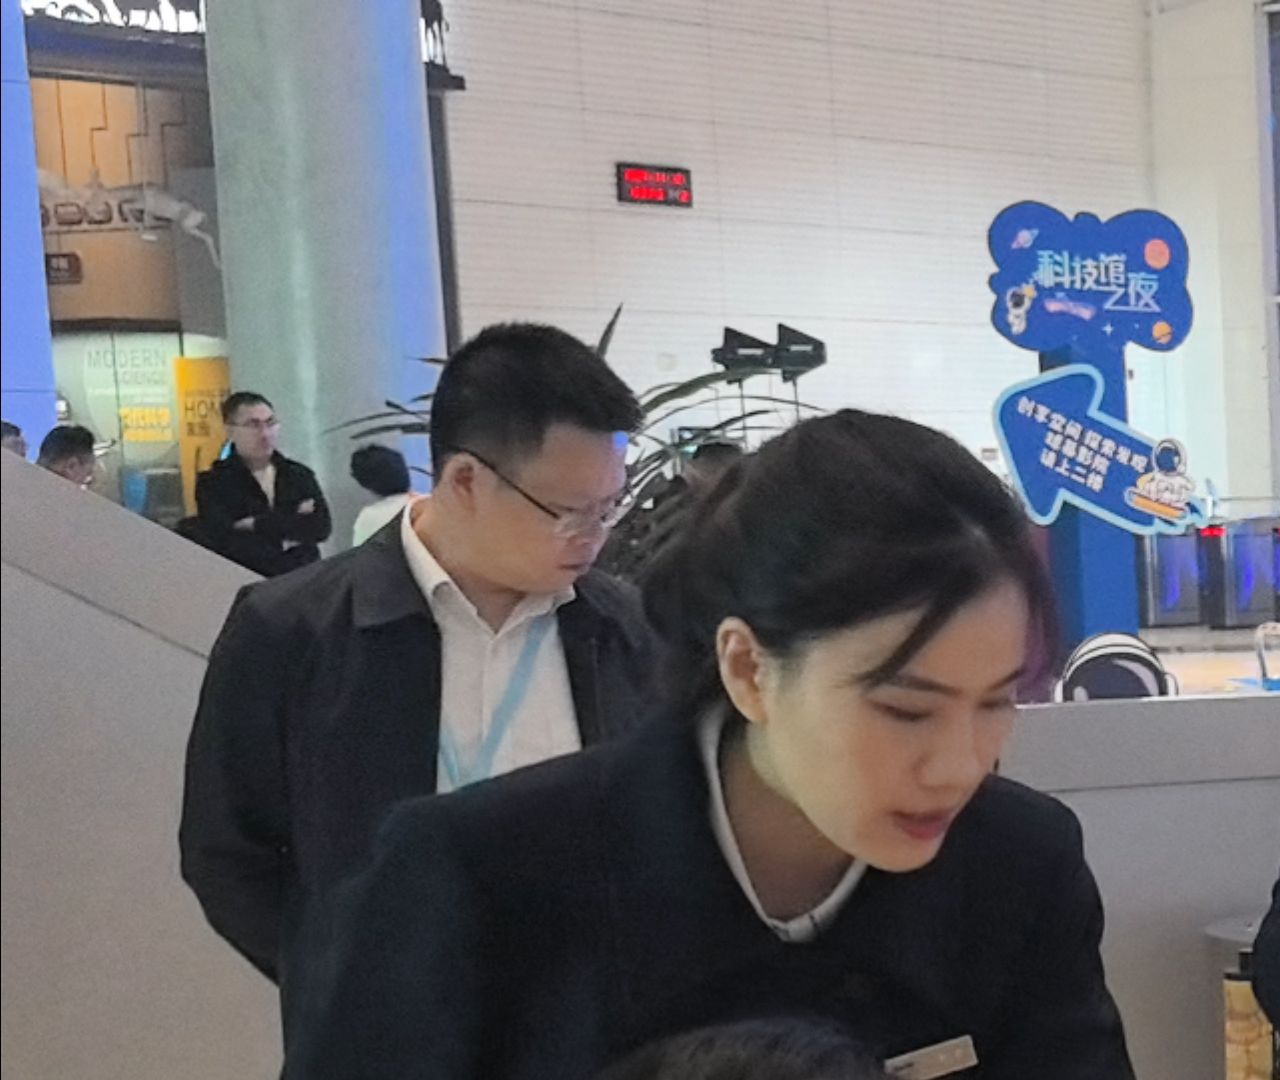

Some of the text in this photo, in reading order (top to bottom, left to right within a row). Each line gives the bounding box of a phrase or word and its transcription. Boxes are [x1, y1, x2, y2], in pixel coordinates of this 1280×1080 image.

[1032, 249, 1162, 314] 科技馆之夜
[1040, 448, 1104, 492] 请上二楼
